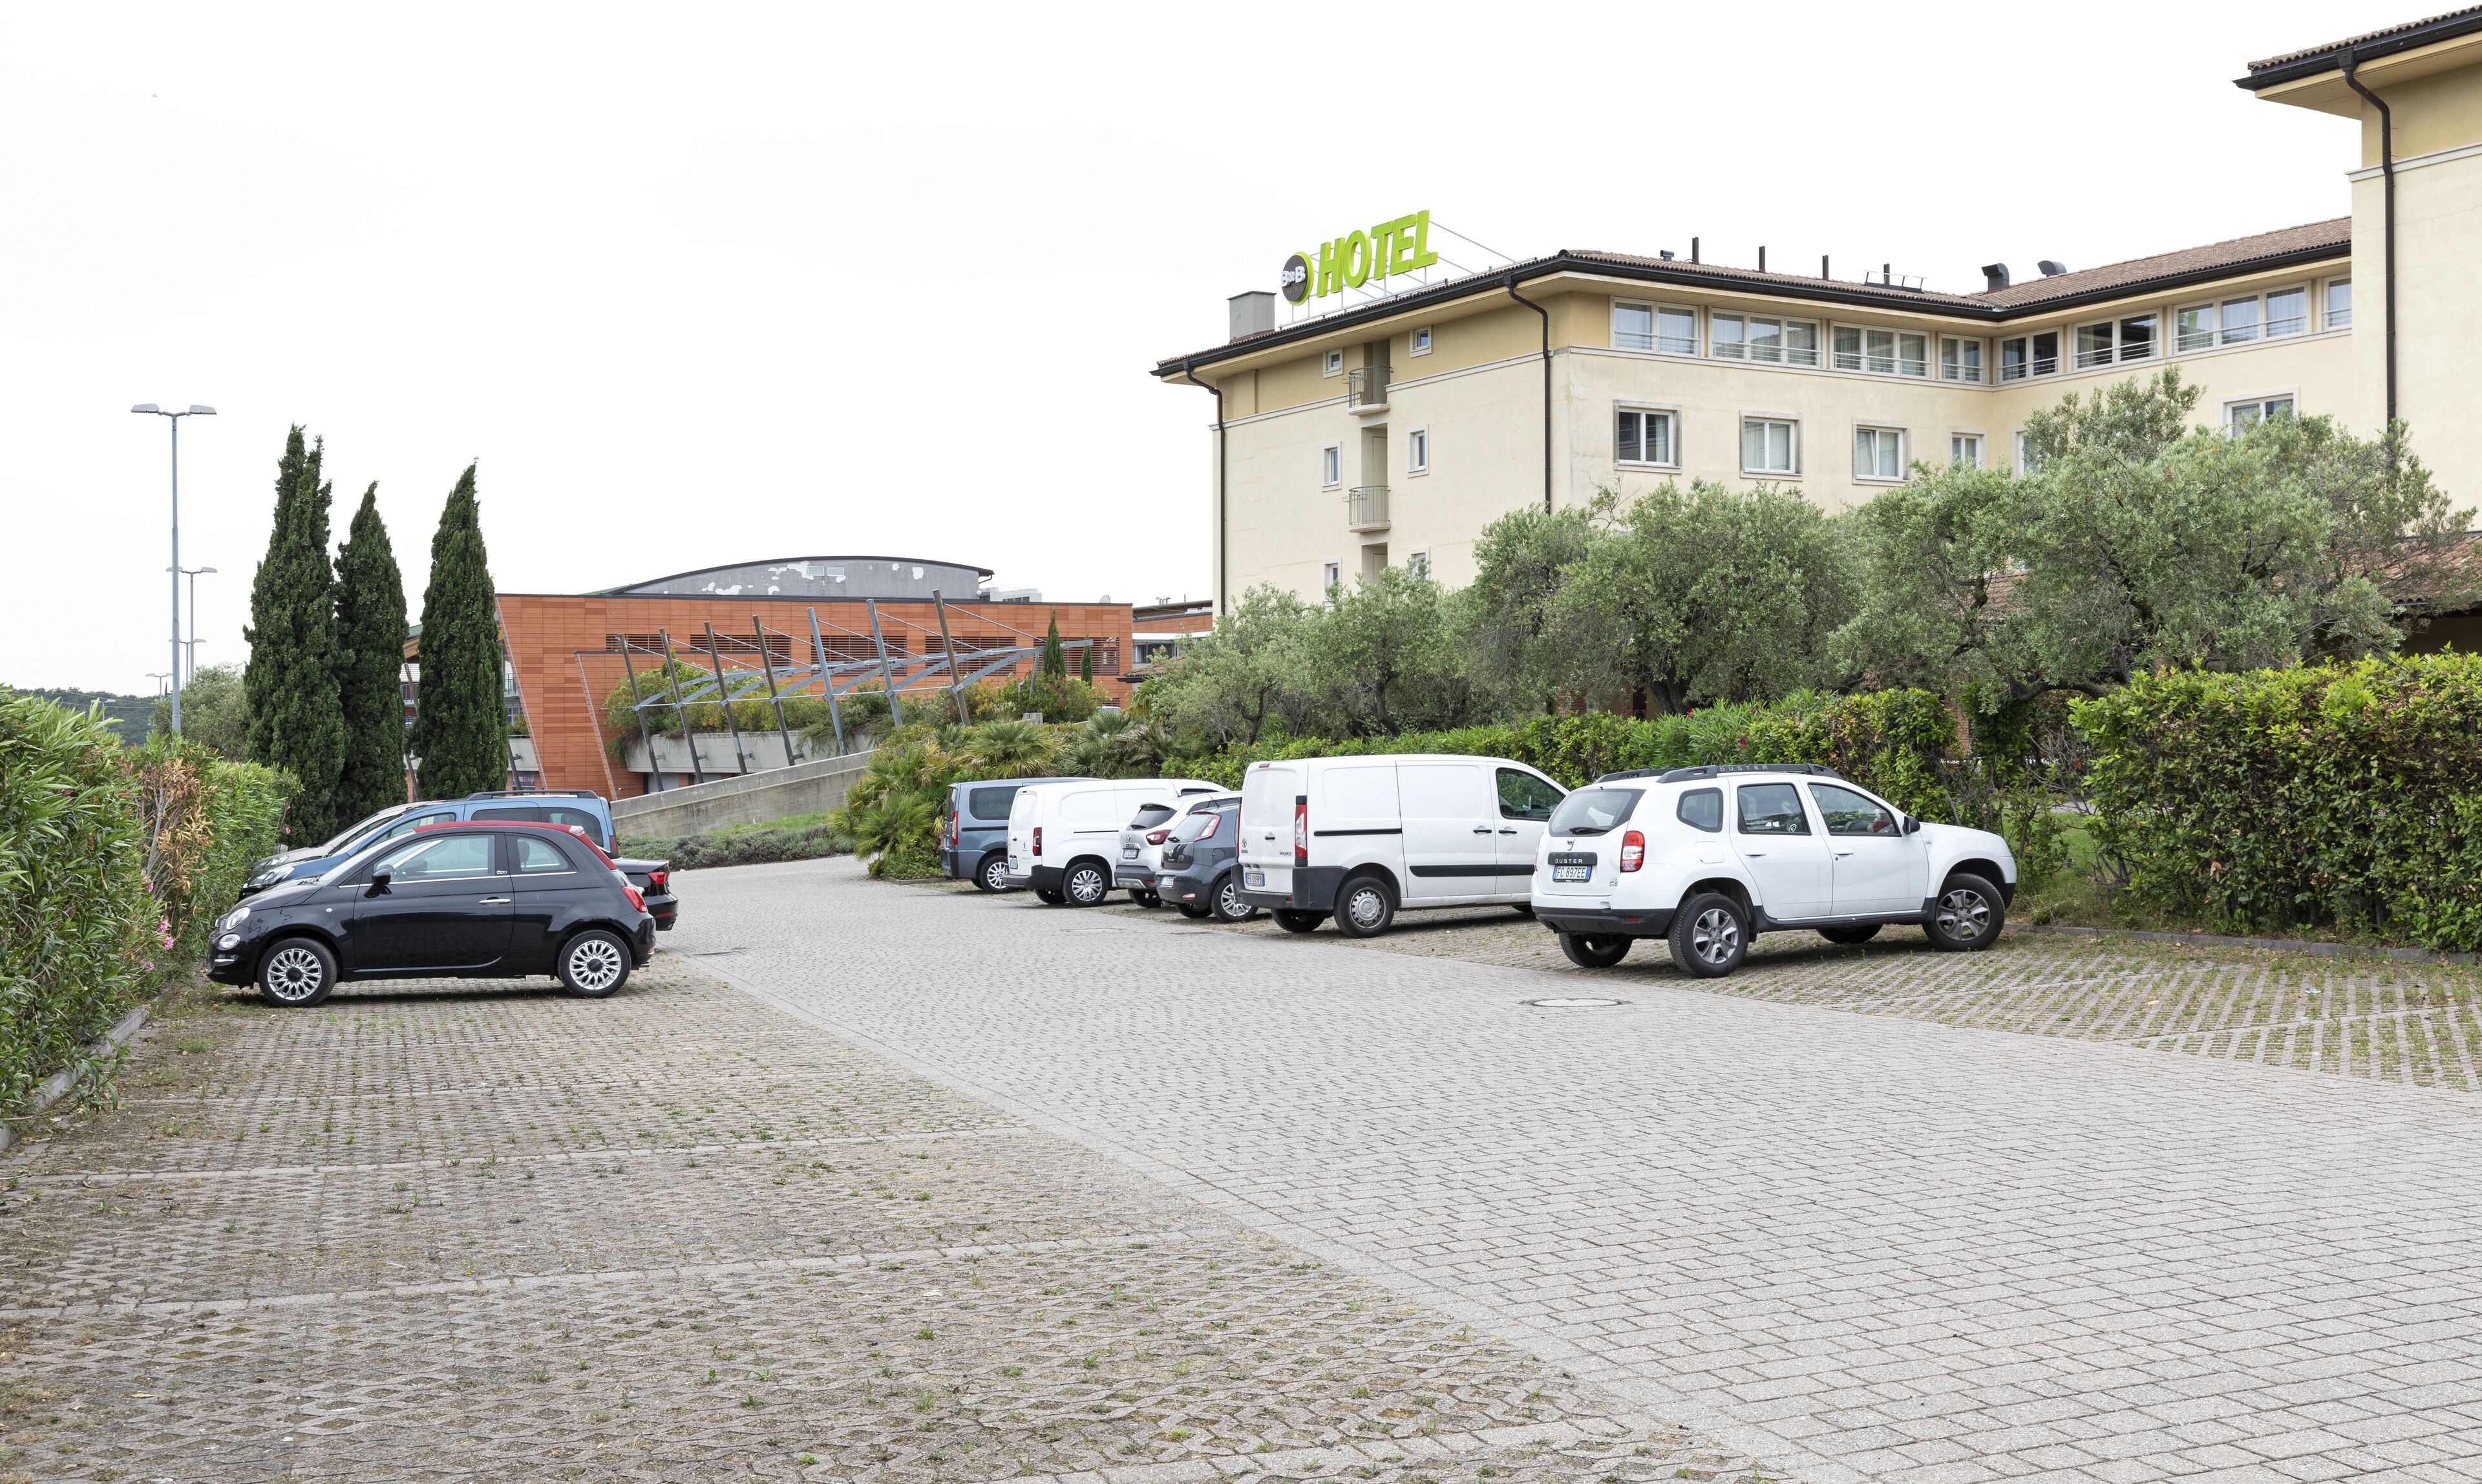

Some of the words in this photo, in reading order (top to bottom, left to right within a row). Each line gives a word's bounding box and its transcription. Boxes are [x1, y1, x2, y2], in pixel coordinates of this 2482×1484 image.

[1317, 209, 1438, 297] HOTEL
[1286, 285, 1303, 293] HOTELS
[1556, 867, 1565, 878] FC
[1565, 867, 1586, 878] 897EE
